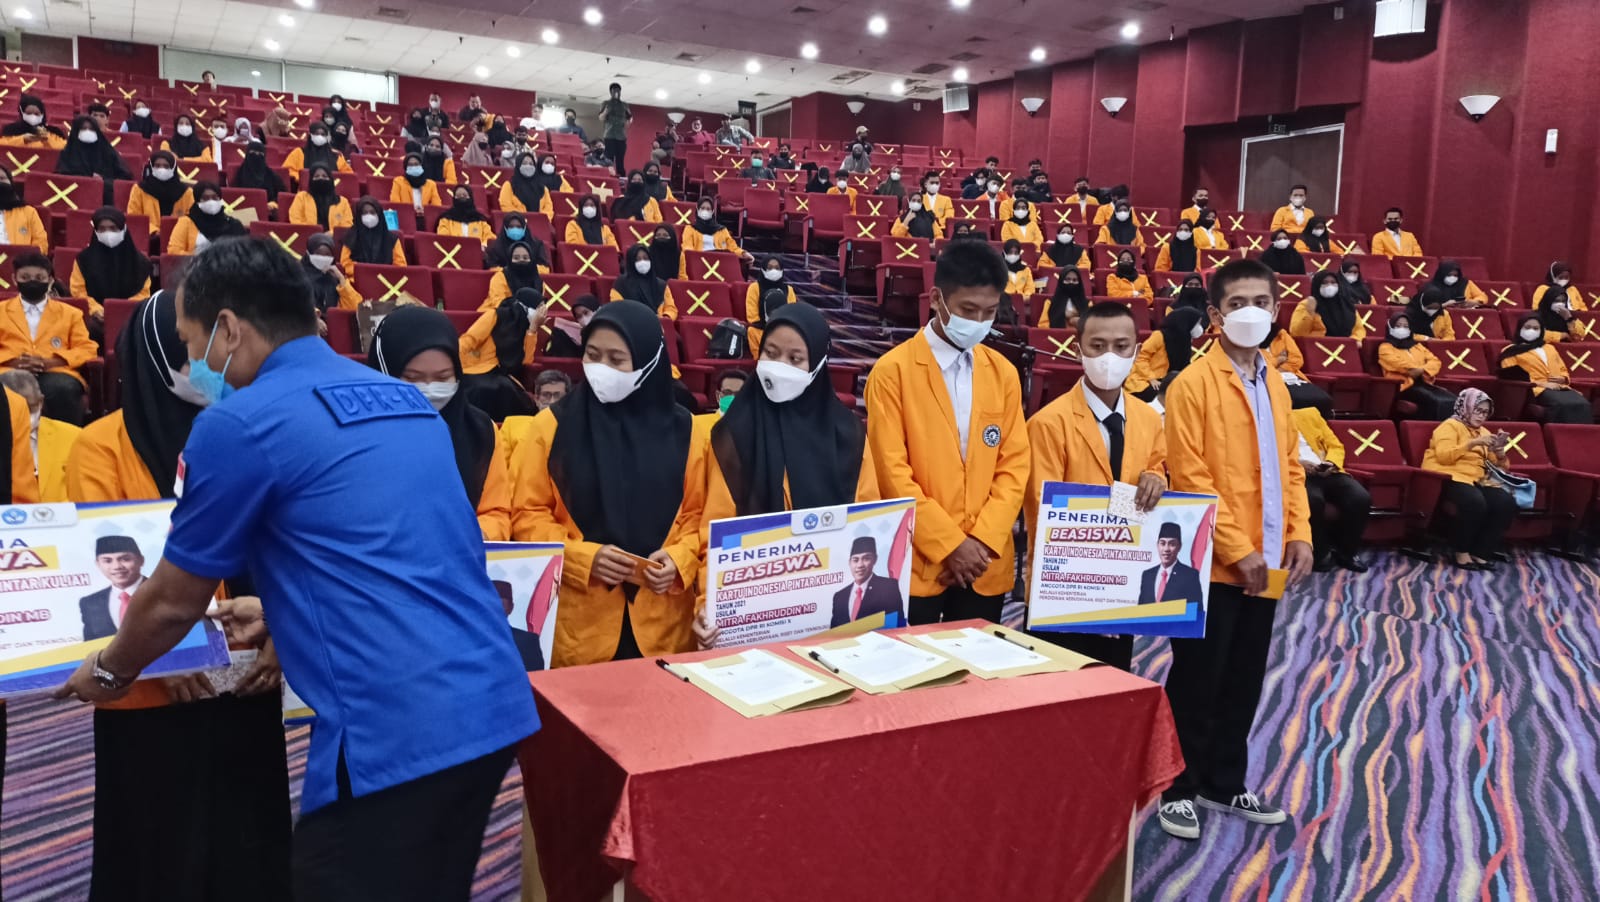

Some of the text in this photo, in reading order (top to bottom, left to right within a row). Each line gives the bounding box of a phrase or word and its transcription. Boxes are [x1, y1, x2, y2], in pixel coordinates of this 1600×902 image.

[1047, 511, 1129, 526] PENERIMA
[1049, 527, 1134, 543] BEASISWA
[718, 541, 815, 565] PENERIMA
[1044, 545, 1152, 562] KARTU INDONESIA PINTAR KULIAH
[722, 552, 821, 586] BEASISWA
[41, 573, 89, 588] KULIAH
[1041, 571, 1128, 585] MITRA FAKHRUDDIN MB
[716, 572, 844, 602] KARTU INDONESIA PINTAR KULIAH
[716, 602, 733, 610] TAHUN
[716, 609, 736, 618] USULAN
[25, 609, 51, 622] MB
[716, 603, 817, 629] MITRA FAKHRUDDIN MB
